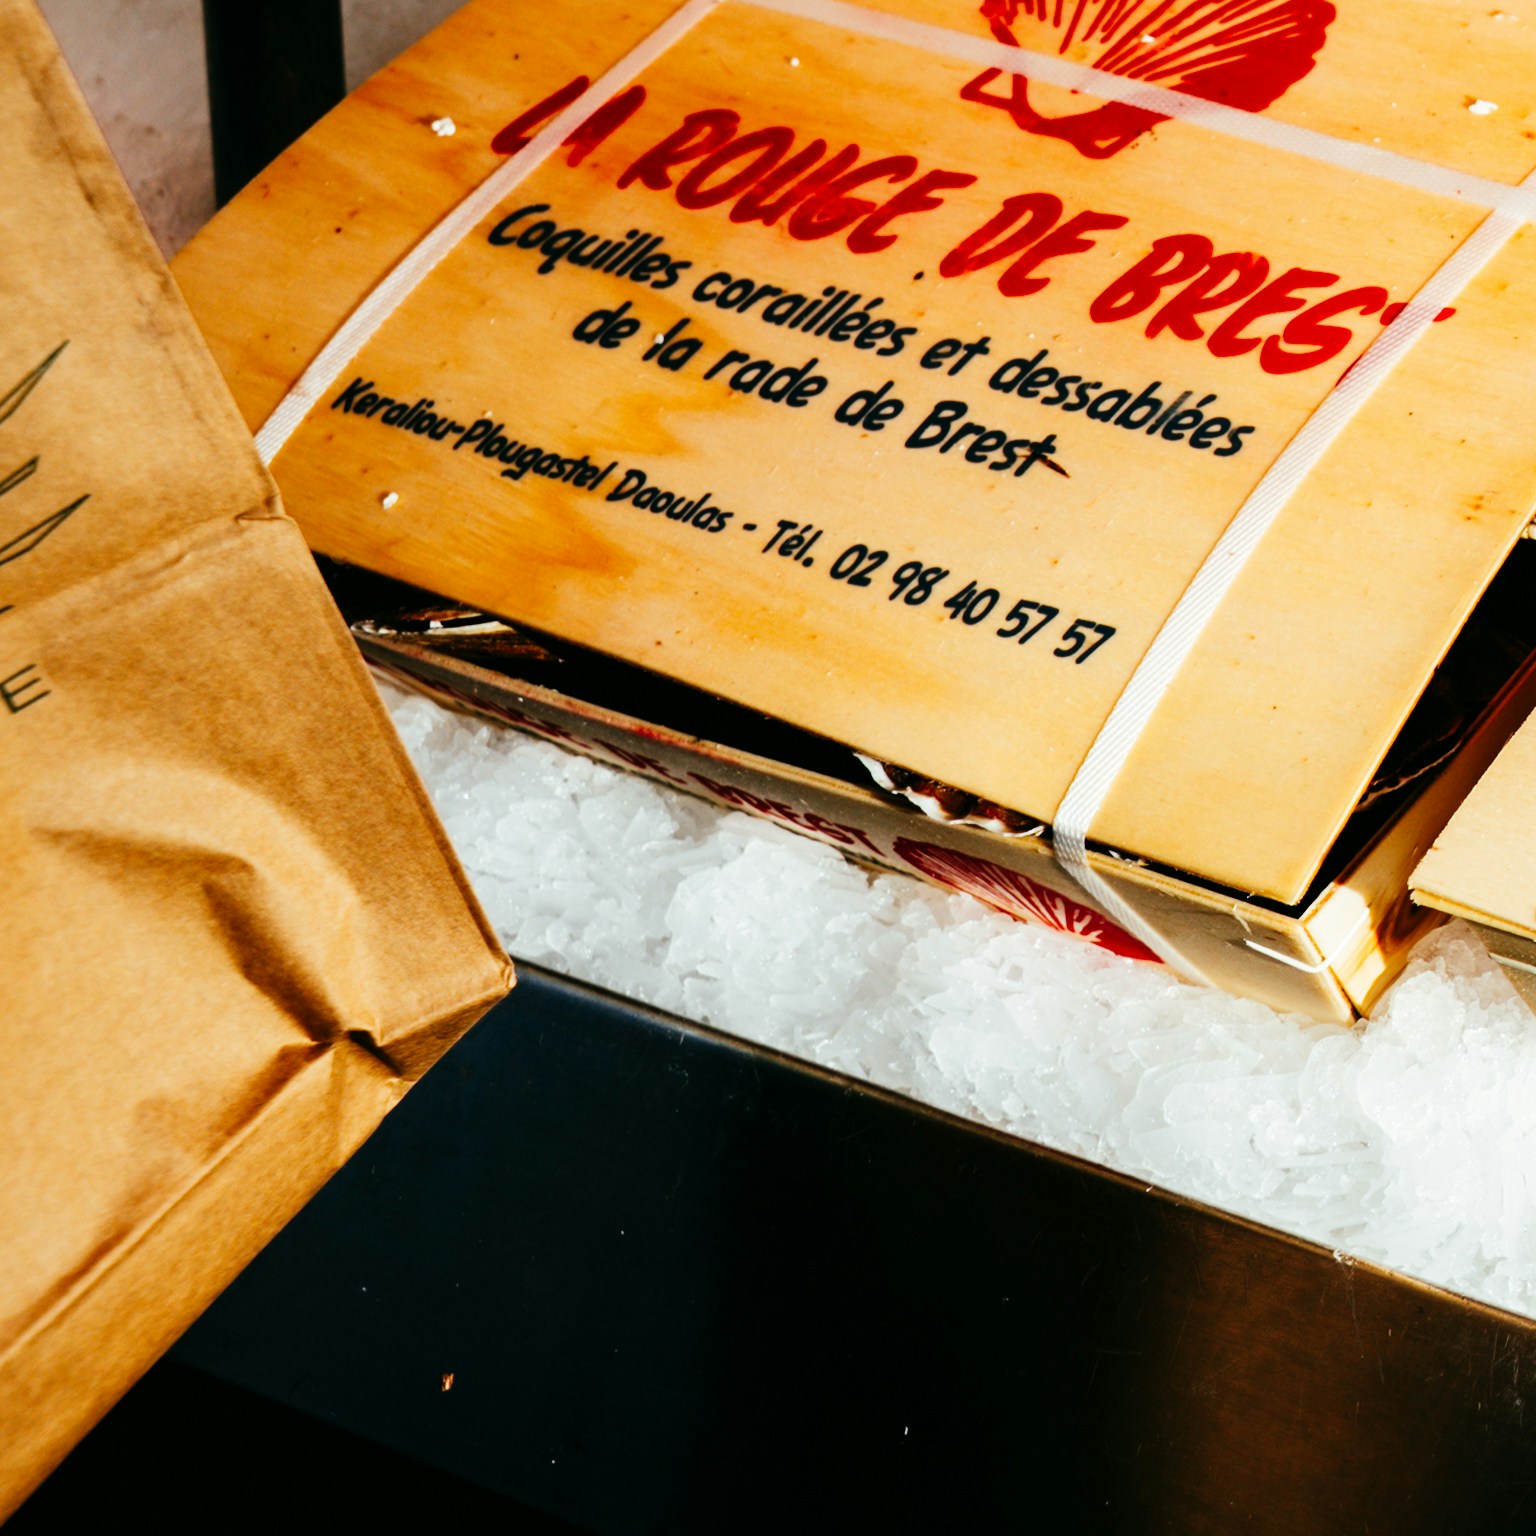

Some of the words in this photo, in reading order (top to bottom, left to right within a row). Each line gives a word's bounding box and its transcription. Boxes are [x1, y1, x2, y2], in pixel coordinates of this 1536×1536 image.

[616, 108, 978, 255] ROUGE
[939, 192, 1130, 298] DE
[487, 204, 693, 289] Coquilles
[692, 271, 918, 357] coraillées
[919, 335, 992, 376] et
[988, 349, 1256, 457] dessablées
[571, 301, 642, 349] de
[642, 318, 705, 372] la
[702, 357, 829, 408] rade
[834, 381, 905, 431] de
[904, 400, 1058, 477] Brest
[330, 376, 619, 492] Keraliou-Plougastel
[605, 468, 734, 534] Daoulas
[761, 519, 824, 569] Tél.
[829, 543, 889, 588] 02
[888, 560, 951, 606] 98
[943, 579, 1001, 626] 40
[996, 599, 1060, 645] 57
[1052, 618, 1117, 665] 57
